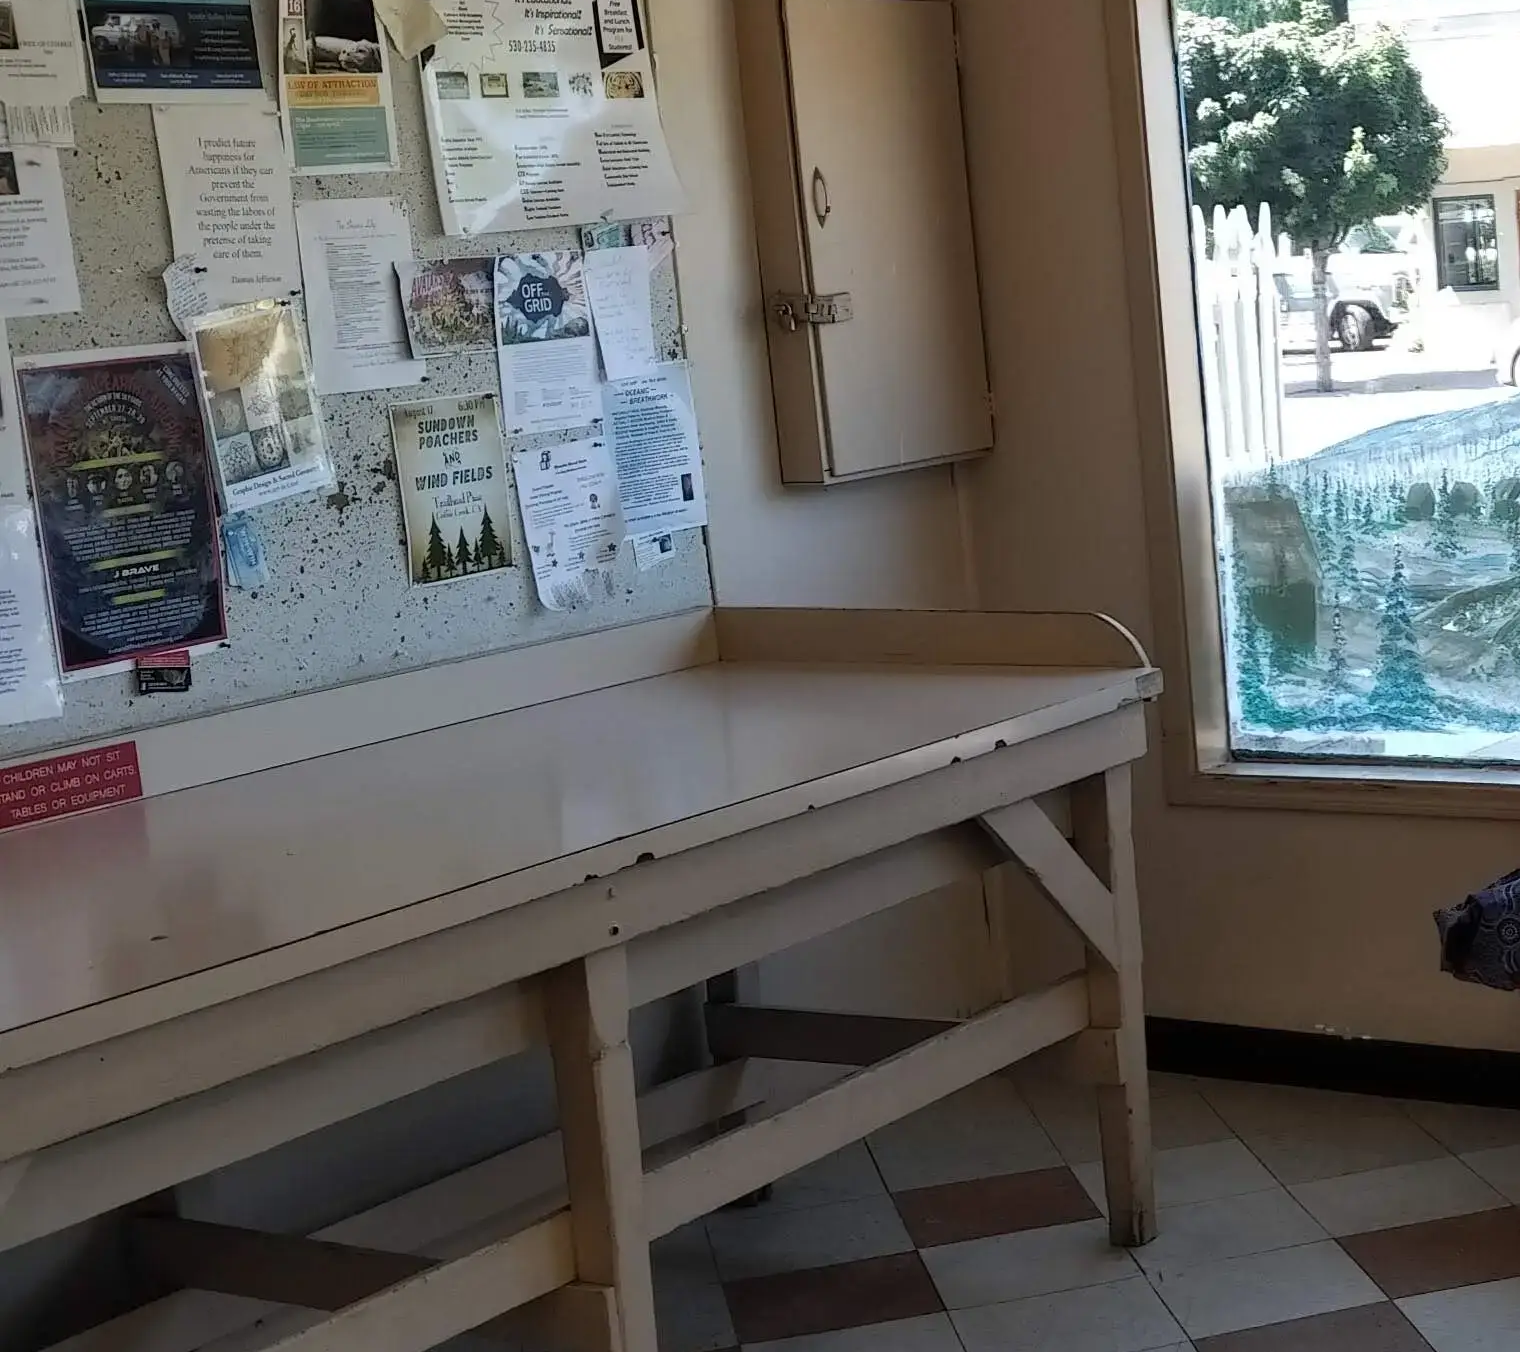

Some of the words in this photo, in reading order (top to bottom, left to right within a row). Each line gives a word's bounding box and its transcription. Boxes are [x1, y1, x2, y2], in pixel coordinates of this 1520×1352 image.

[203, 137, 232, 149] predict
[232, 137, 257, 149] future
[188, 165, 231, 176] Americans
[240, 165, 258, 177] they
[211, 180, 241, 191] prevent
[199, 193, 249, 203] Government
[521, 282, 543, 299] OFF
[524, 297, 553, 313] GRID
[417, 414, 475, 435] SUNDOWN
[418, 428, 479, 450] POACHERS
[442, 450, 462, 467] AND
[415, 472, 449, 492] WIND
[452, 465, 494, 486] FIELDS
[120, 563, 161, 578] BRAVE
[2, 764, 55, 786] CHILDREN
[56, 759, 79, 774] MAY
[81, 754, 102, 769] NOT
[106, 750, 122, 763] SIT
[0, 788, 26, 804] TAND
[30, 784, 47, 798] OR
[50, 777, 82, 794] CLIMB
[84, 771, 101, 785] ON
[10, 803, 48, 820] TABLES
[51, 796, 67, 811] OR
[70, 783, 127, 806] EQUIPMENT
